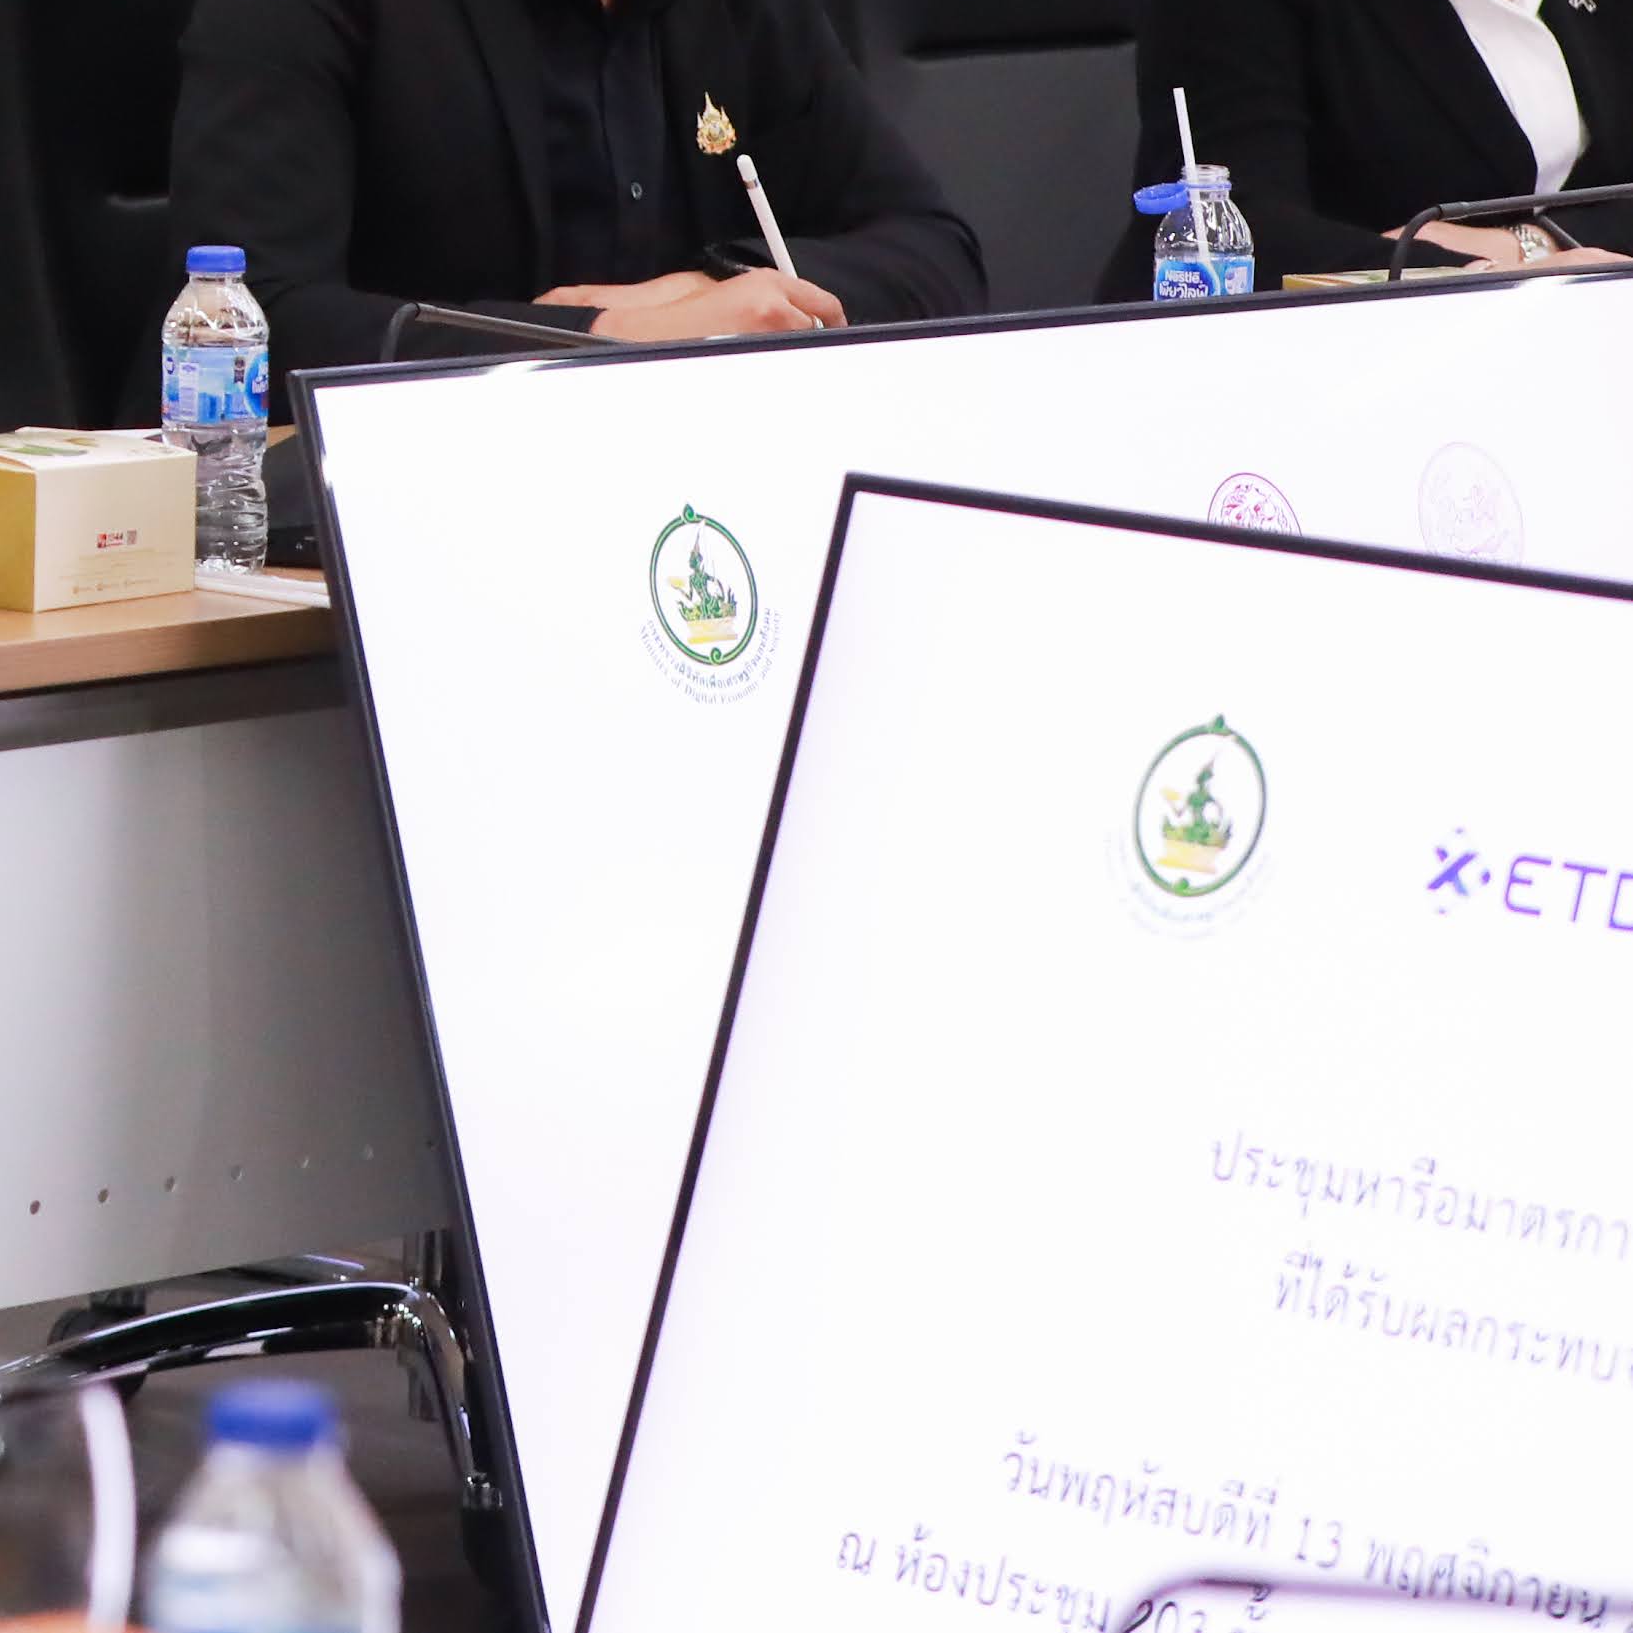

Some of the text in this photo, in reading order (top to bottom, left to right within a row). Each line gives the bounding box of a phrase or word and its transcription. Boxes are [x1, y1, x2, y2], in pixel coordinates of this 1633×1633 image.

[1275, 1240, 1633, 1388] ที่ได้รับผลกระทบ
[1003, 1429, 1279, 1550] วันพฤหัสบดีที่
[1295, 1514, 1343, 1570] 13
[837, 1532, 877, 1576] ณ
[895, 1523, 1112, 1633] ห้องประชม
